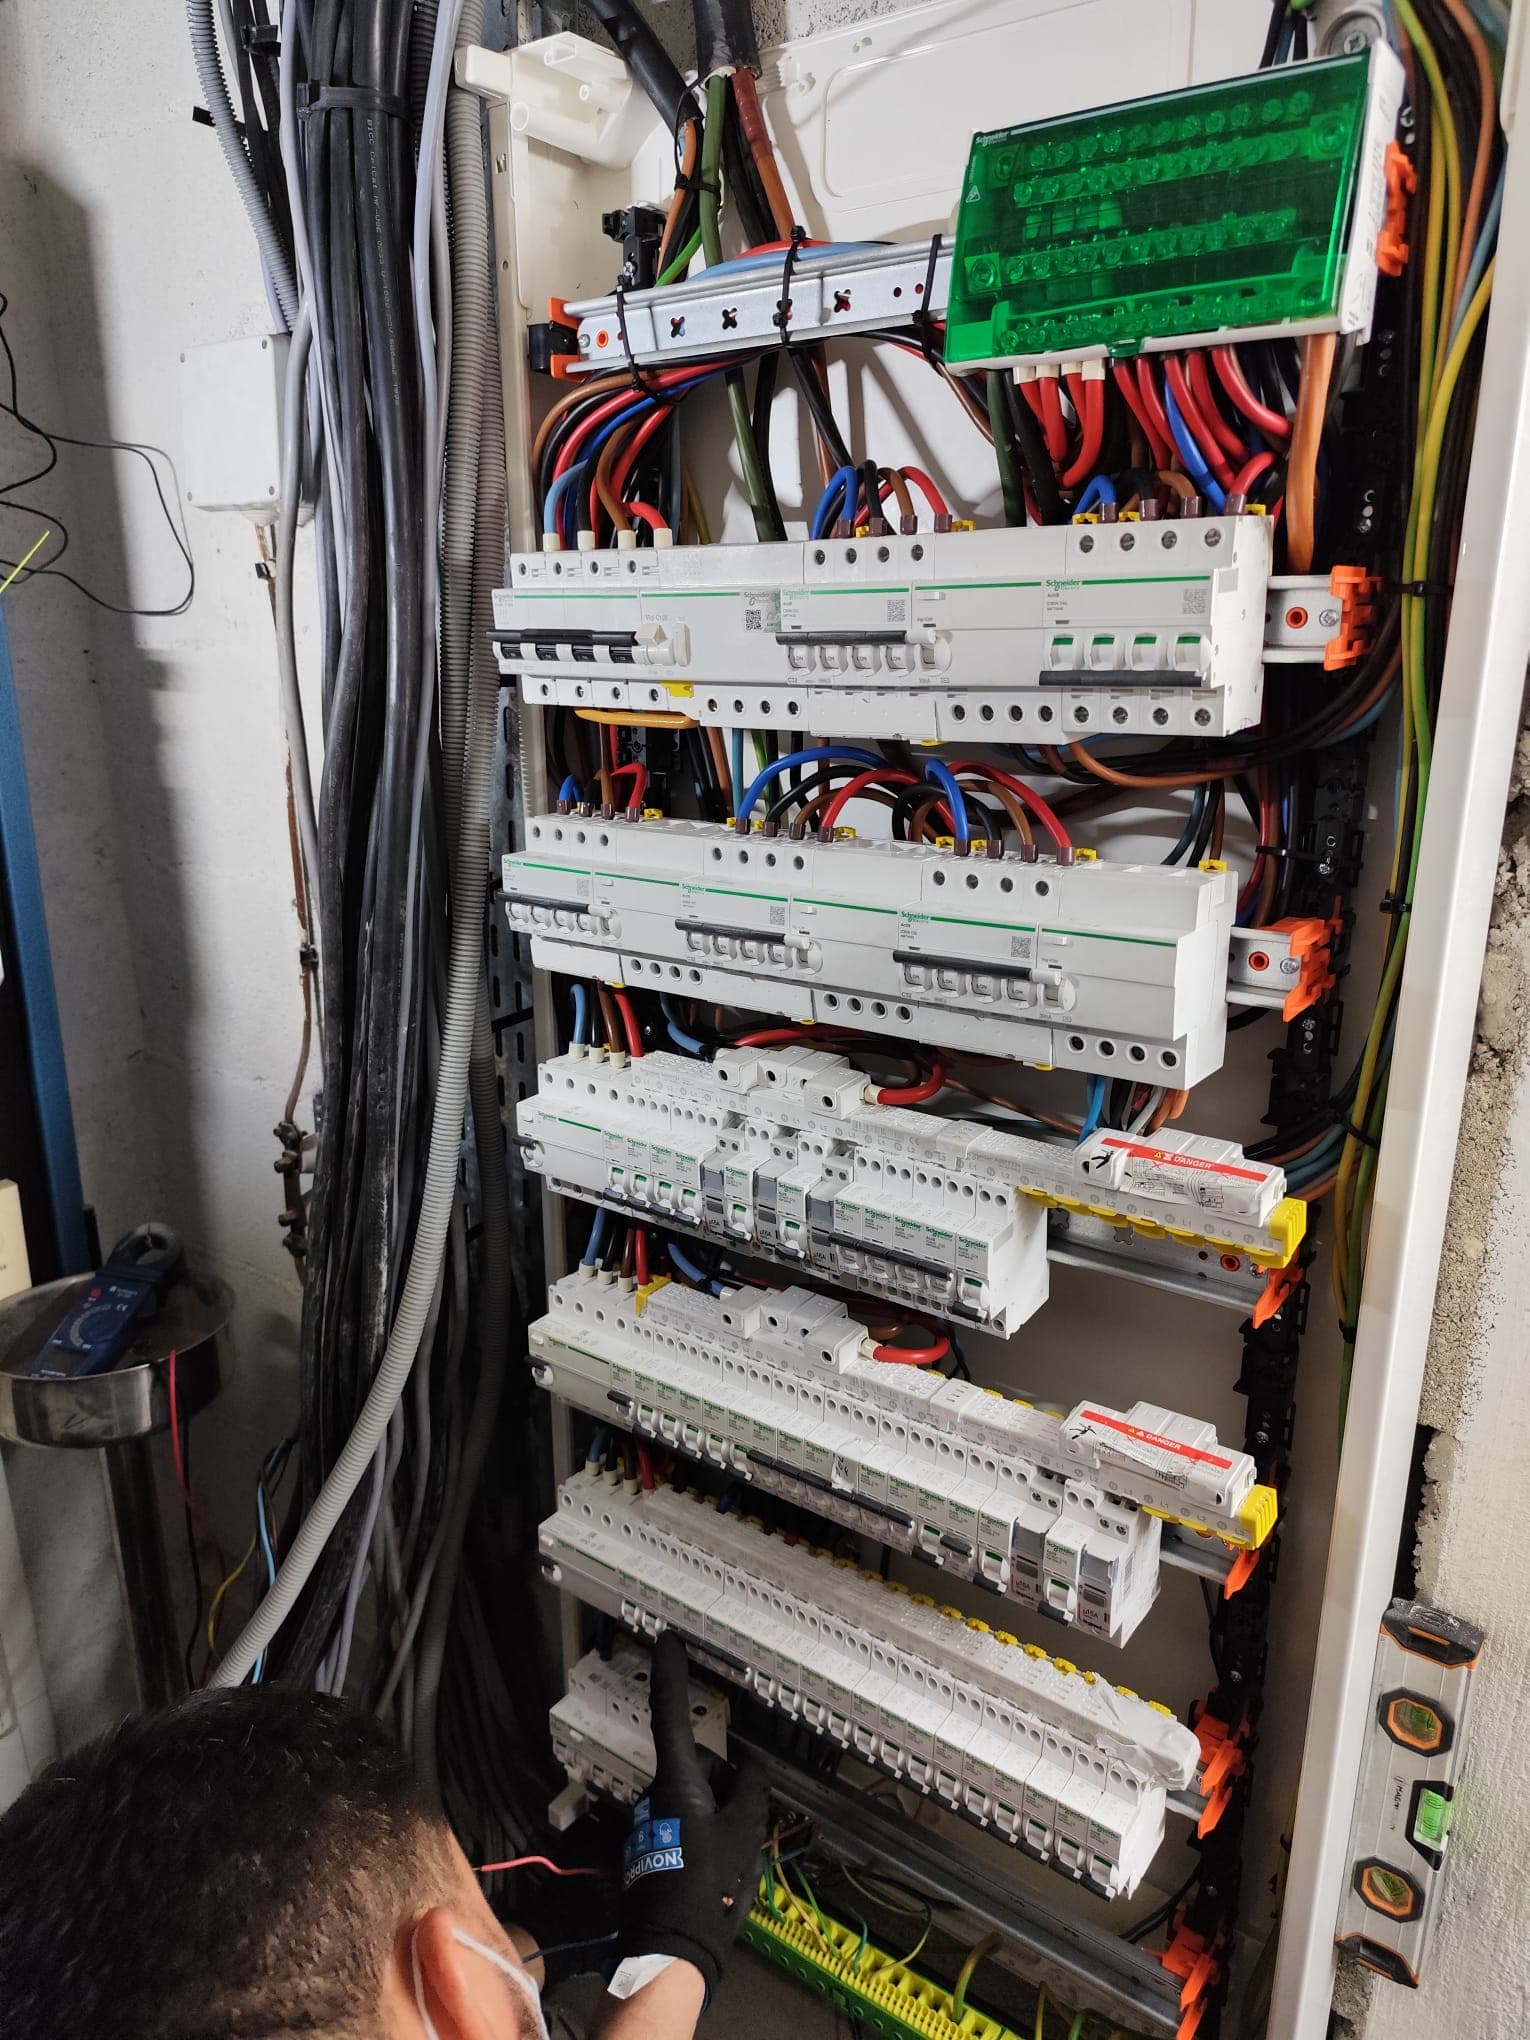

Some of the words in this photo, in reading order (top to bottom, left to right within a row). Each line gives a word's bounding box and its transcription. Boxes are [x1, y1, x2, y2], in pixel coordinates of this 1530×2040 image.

[1046, 579, 1082, 591] Schneider
[901, 911, 930, 923] Schneider
[864, 1208, 892, 1220] Schneider
[895, 1217, 922, 1230] Schneider
[926, 1226, 953, 1239] Schneider
[959, 1236, 988, 1249] Schneider
[1146, 1433, 1182, 1450] DANGER
[1046, 1540, 1075, 1556] Schneider
